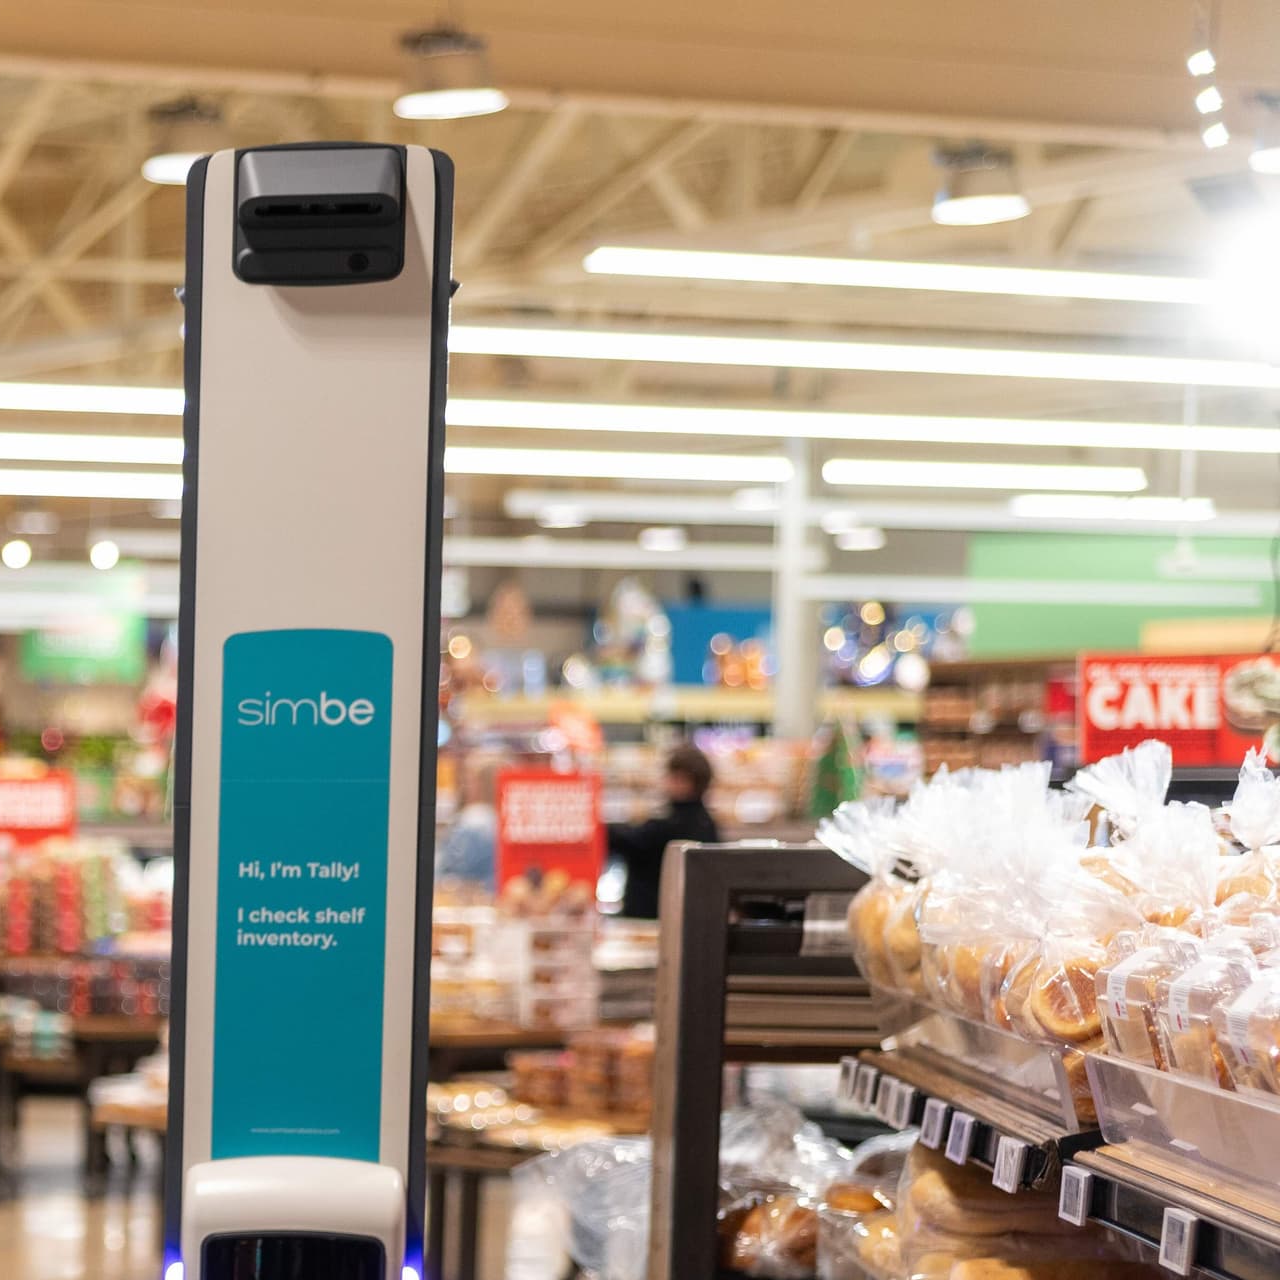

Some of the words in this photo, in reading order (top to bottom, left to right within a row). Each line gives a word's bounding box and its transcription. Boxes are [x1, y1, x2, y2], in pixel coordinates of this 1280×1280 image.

[237, 690, 376, 726] simbe
[1087, 677, 1219, 730] CAKE
[238, 861, 266, 881] Hi,
[270, 861, 302, 879] I'm
[306, 861, 361, 882] Tally!
[237, 907, 244, 924] I
[248, 907, 310, 924] check
[314, 907, 366, 925] shelf
[236, 930, 338, 950] inventory.
